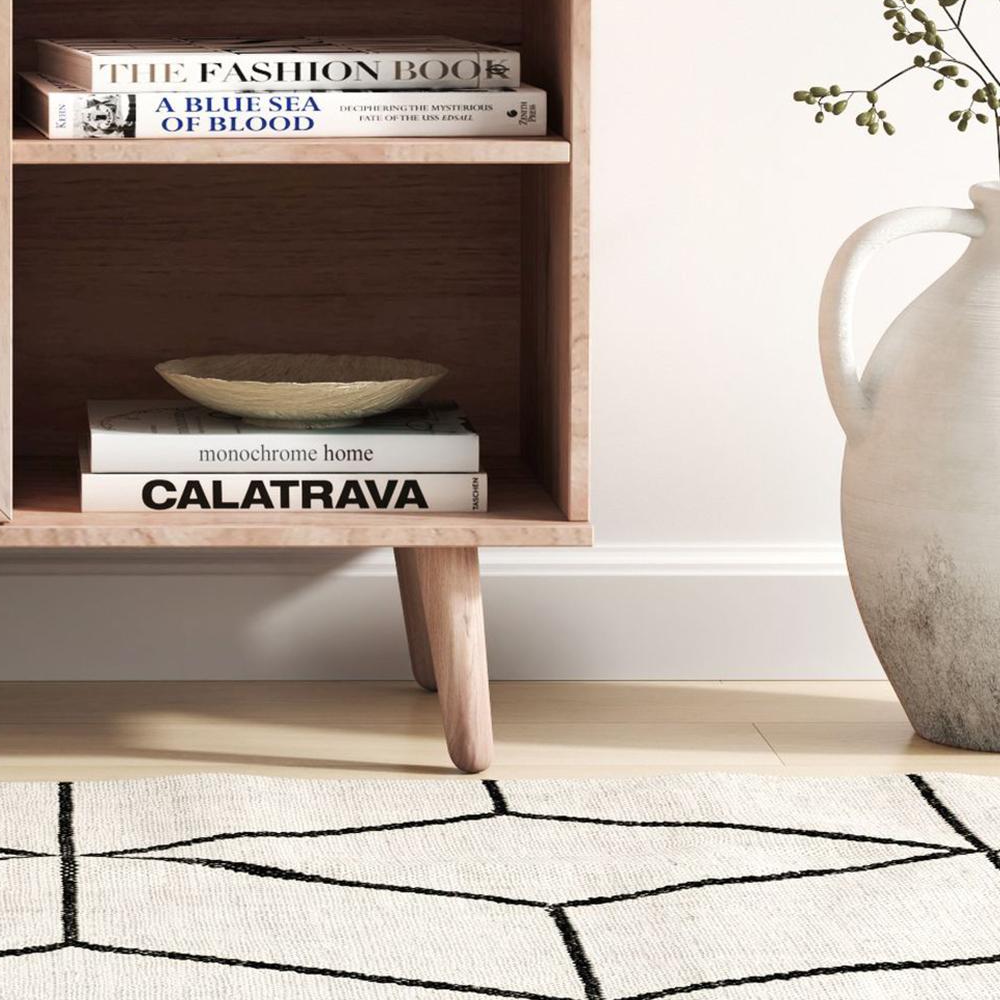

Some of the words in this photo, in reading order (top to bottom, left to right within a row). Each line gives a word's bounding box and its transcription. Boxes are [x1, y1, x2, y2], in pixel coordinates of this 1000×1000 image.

[100, 63, 187, 83] THE
[201, 61, 382, 82] FASHION
[394, 59, 510, 80] BOOK
[154, 97, 176, 113] A
[185, 96, 261, 113] BLUE
[269, 96, 321, 112] SEA
[339, 104, 407, 112] DECIPHERING
[161, 116, 200, 132] OF
[208, 116, 315, 132] BLOOD
[359, 114, 383, 122] FATE
[385, 114, 398, 122] OF
[400, 114, 418, 122] THE
[200, 443, 317, 463] monochrome
[324, 443, 374, 462] home
[142, 479, 429, 510] CALATRAVA
[472, 477, 480, 511] TASCHEN
